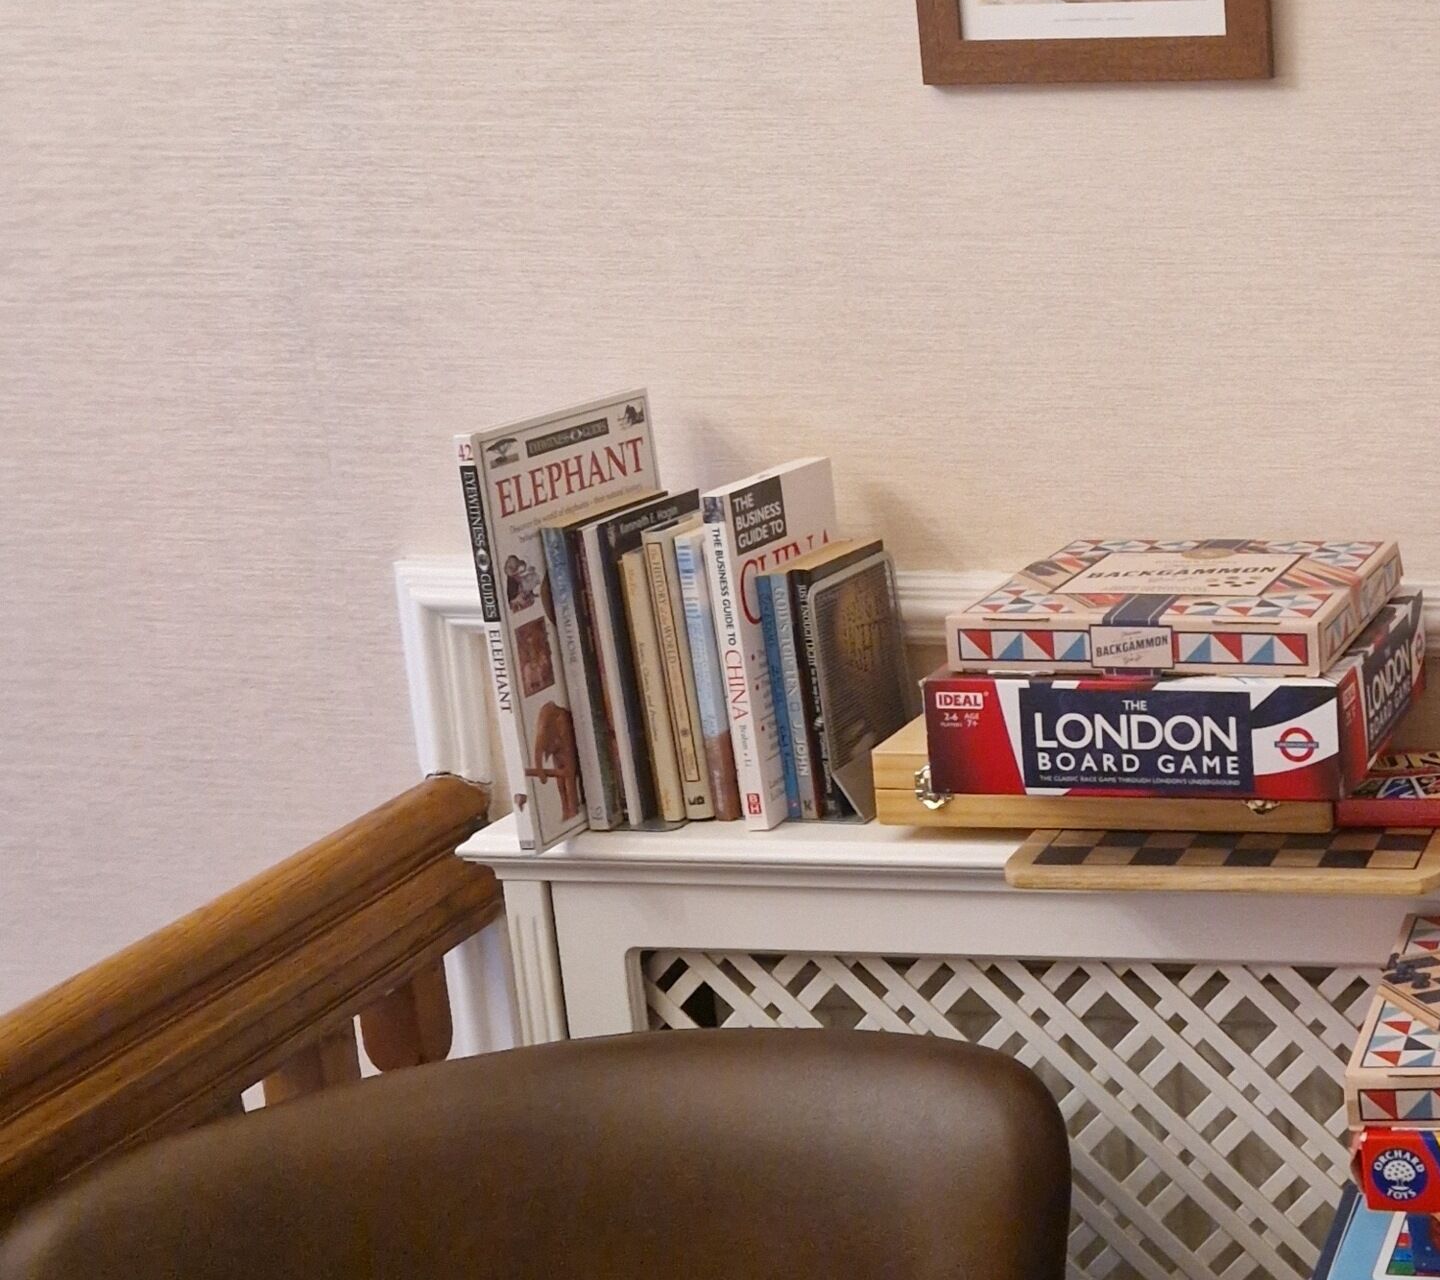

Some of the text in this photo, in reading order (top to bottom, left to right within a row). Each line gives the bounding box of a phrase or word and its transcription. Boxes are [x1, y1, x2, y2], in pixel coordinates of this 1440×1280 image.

[458, 444, 473, 461] 42
[494, 437, 644, 518] ELEPHANT
[733, 493, 754, 512] THE
[735, 502, 782, 531] BUSINESS
[462, 470, 498, 619] EYEWITNESS GUIDES
[738, 519, 785, 548] GUIDE TO
[1086, 565, 1279, 579] BACKGAMMON
[796, 583, 808, 601] JUST
[652, 561, 666, 604] HISTORY
[663, 625, 676, 664] WORLD
[711, 527, 749, 720] THE BUSINESS GUIDE TO CHINA
[800, 604, 813, 640] ENOUGH
[1096, 635, 1169, 658] BACKGAMMON
[487, 627, 514, 714] ELEPHANT
[773, 586, 789, 632] GOD'S
[794, 737, 809, 776] JOHN
[1367, 640, 1411, 718] LONDON
[938, 695, 981, 707] IDEAL
[1122, 699, 1148, 711] THE
[964, 712, 980, 720] AGE
[1369, 700, 1393, 740] BOARD
[1034, 712, 1238, 752] LONDON
[1037, 752, 1240, 775] BOARD GAME
[1080, 775, 1097, 783] RACE
[1118, 777, 1151, 785] THROUGH
[1189, 778, 1240, 786] UNDERGROUND
[1374, 1149, 1426, 1173] ORCHARD
[1387, 1188, 1417, 1200] TOYS
